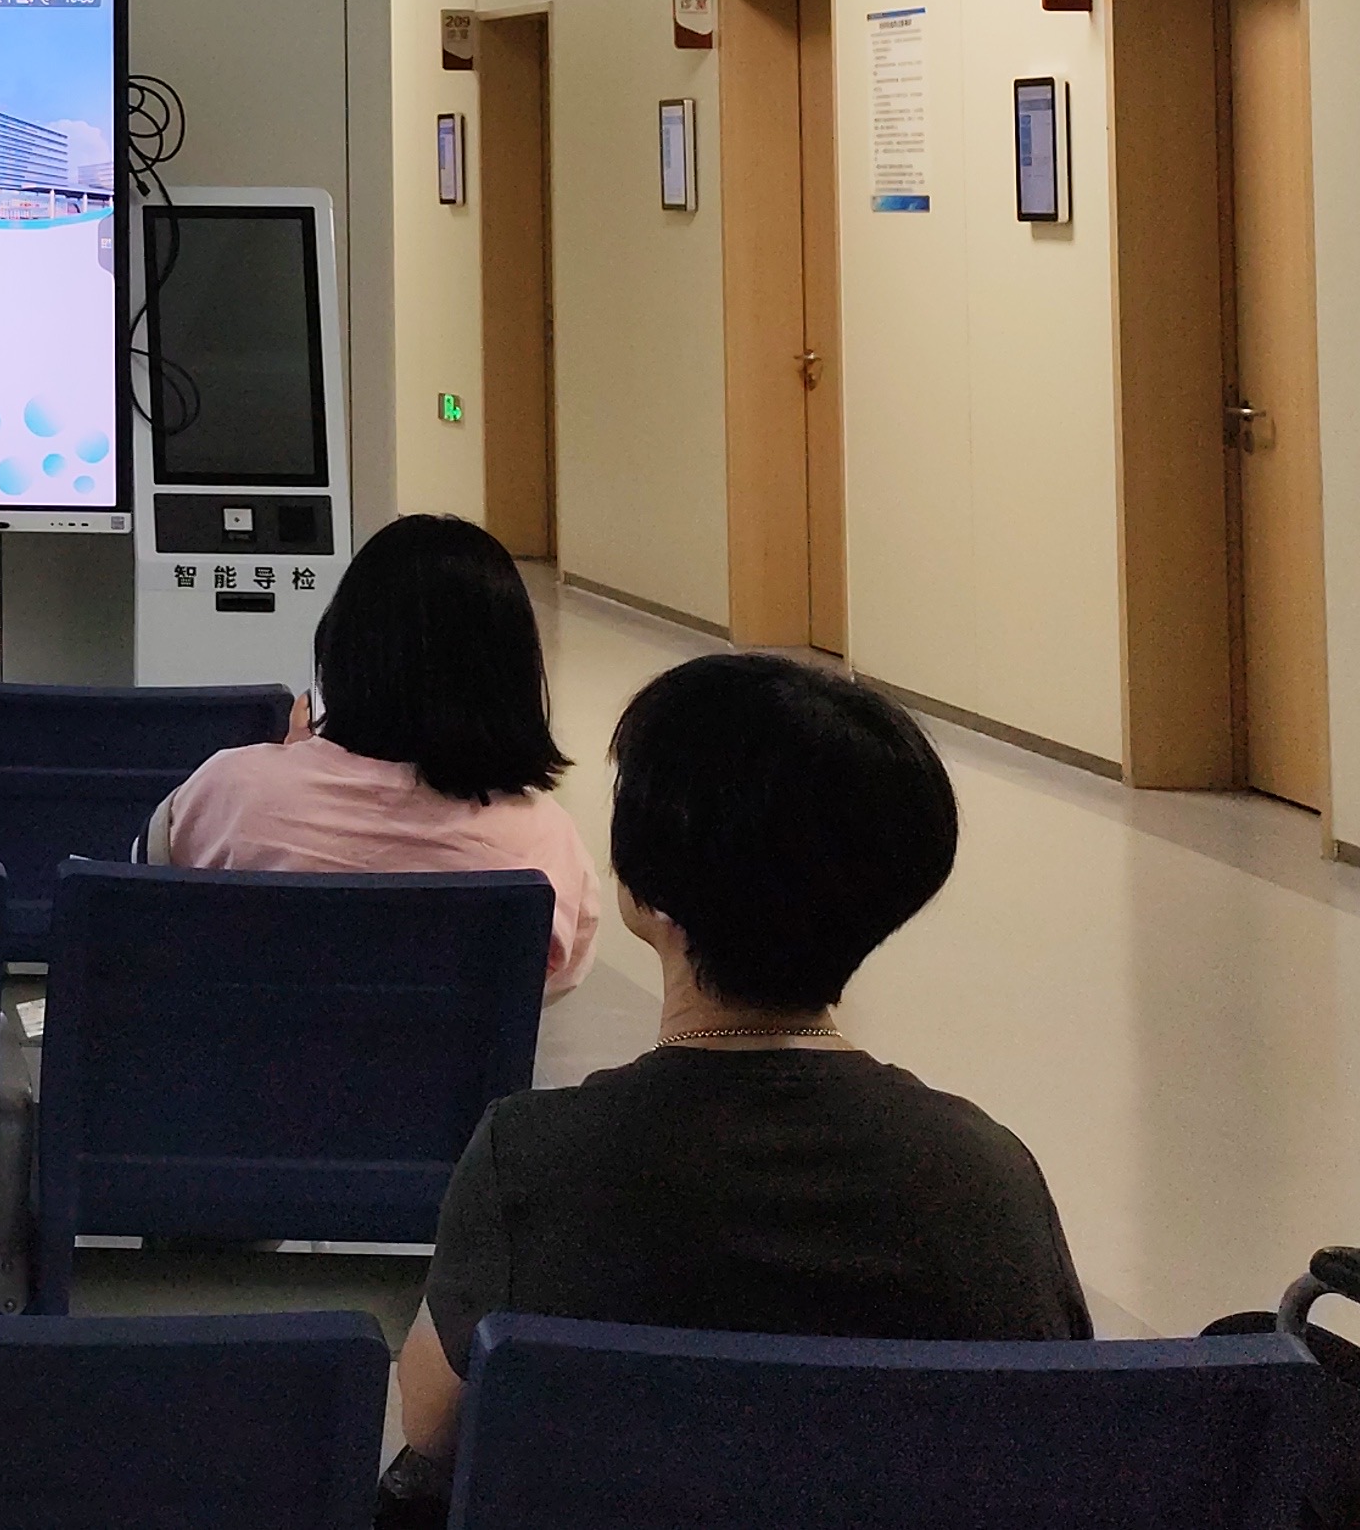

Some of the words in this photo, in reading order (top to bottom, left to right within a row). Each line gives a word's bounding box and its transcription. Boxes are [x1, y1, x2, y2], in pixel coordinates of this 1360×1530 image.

[445, 15, 471, 28] 209
[173, 564, 316, 591] 智能导检
